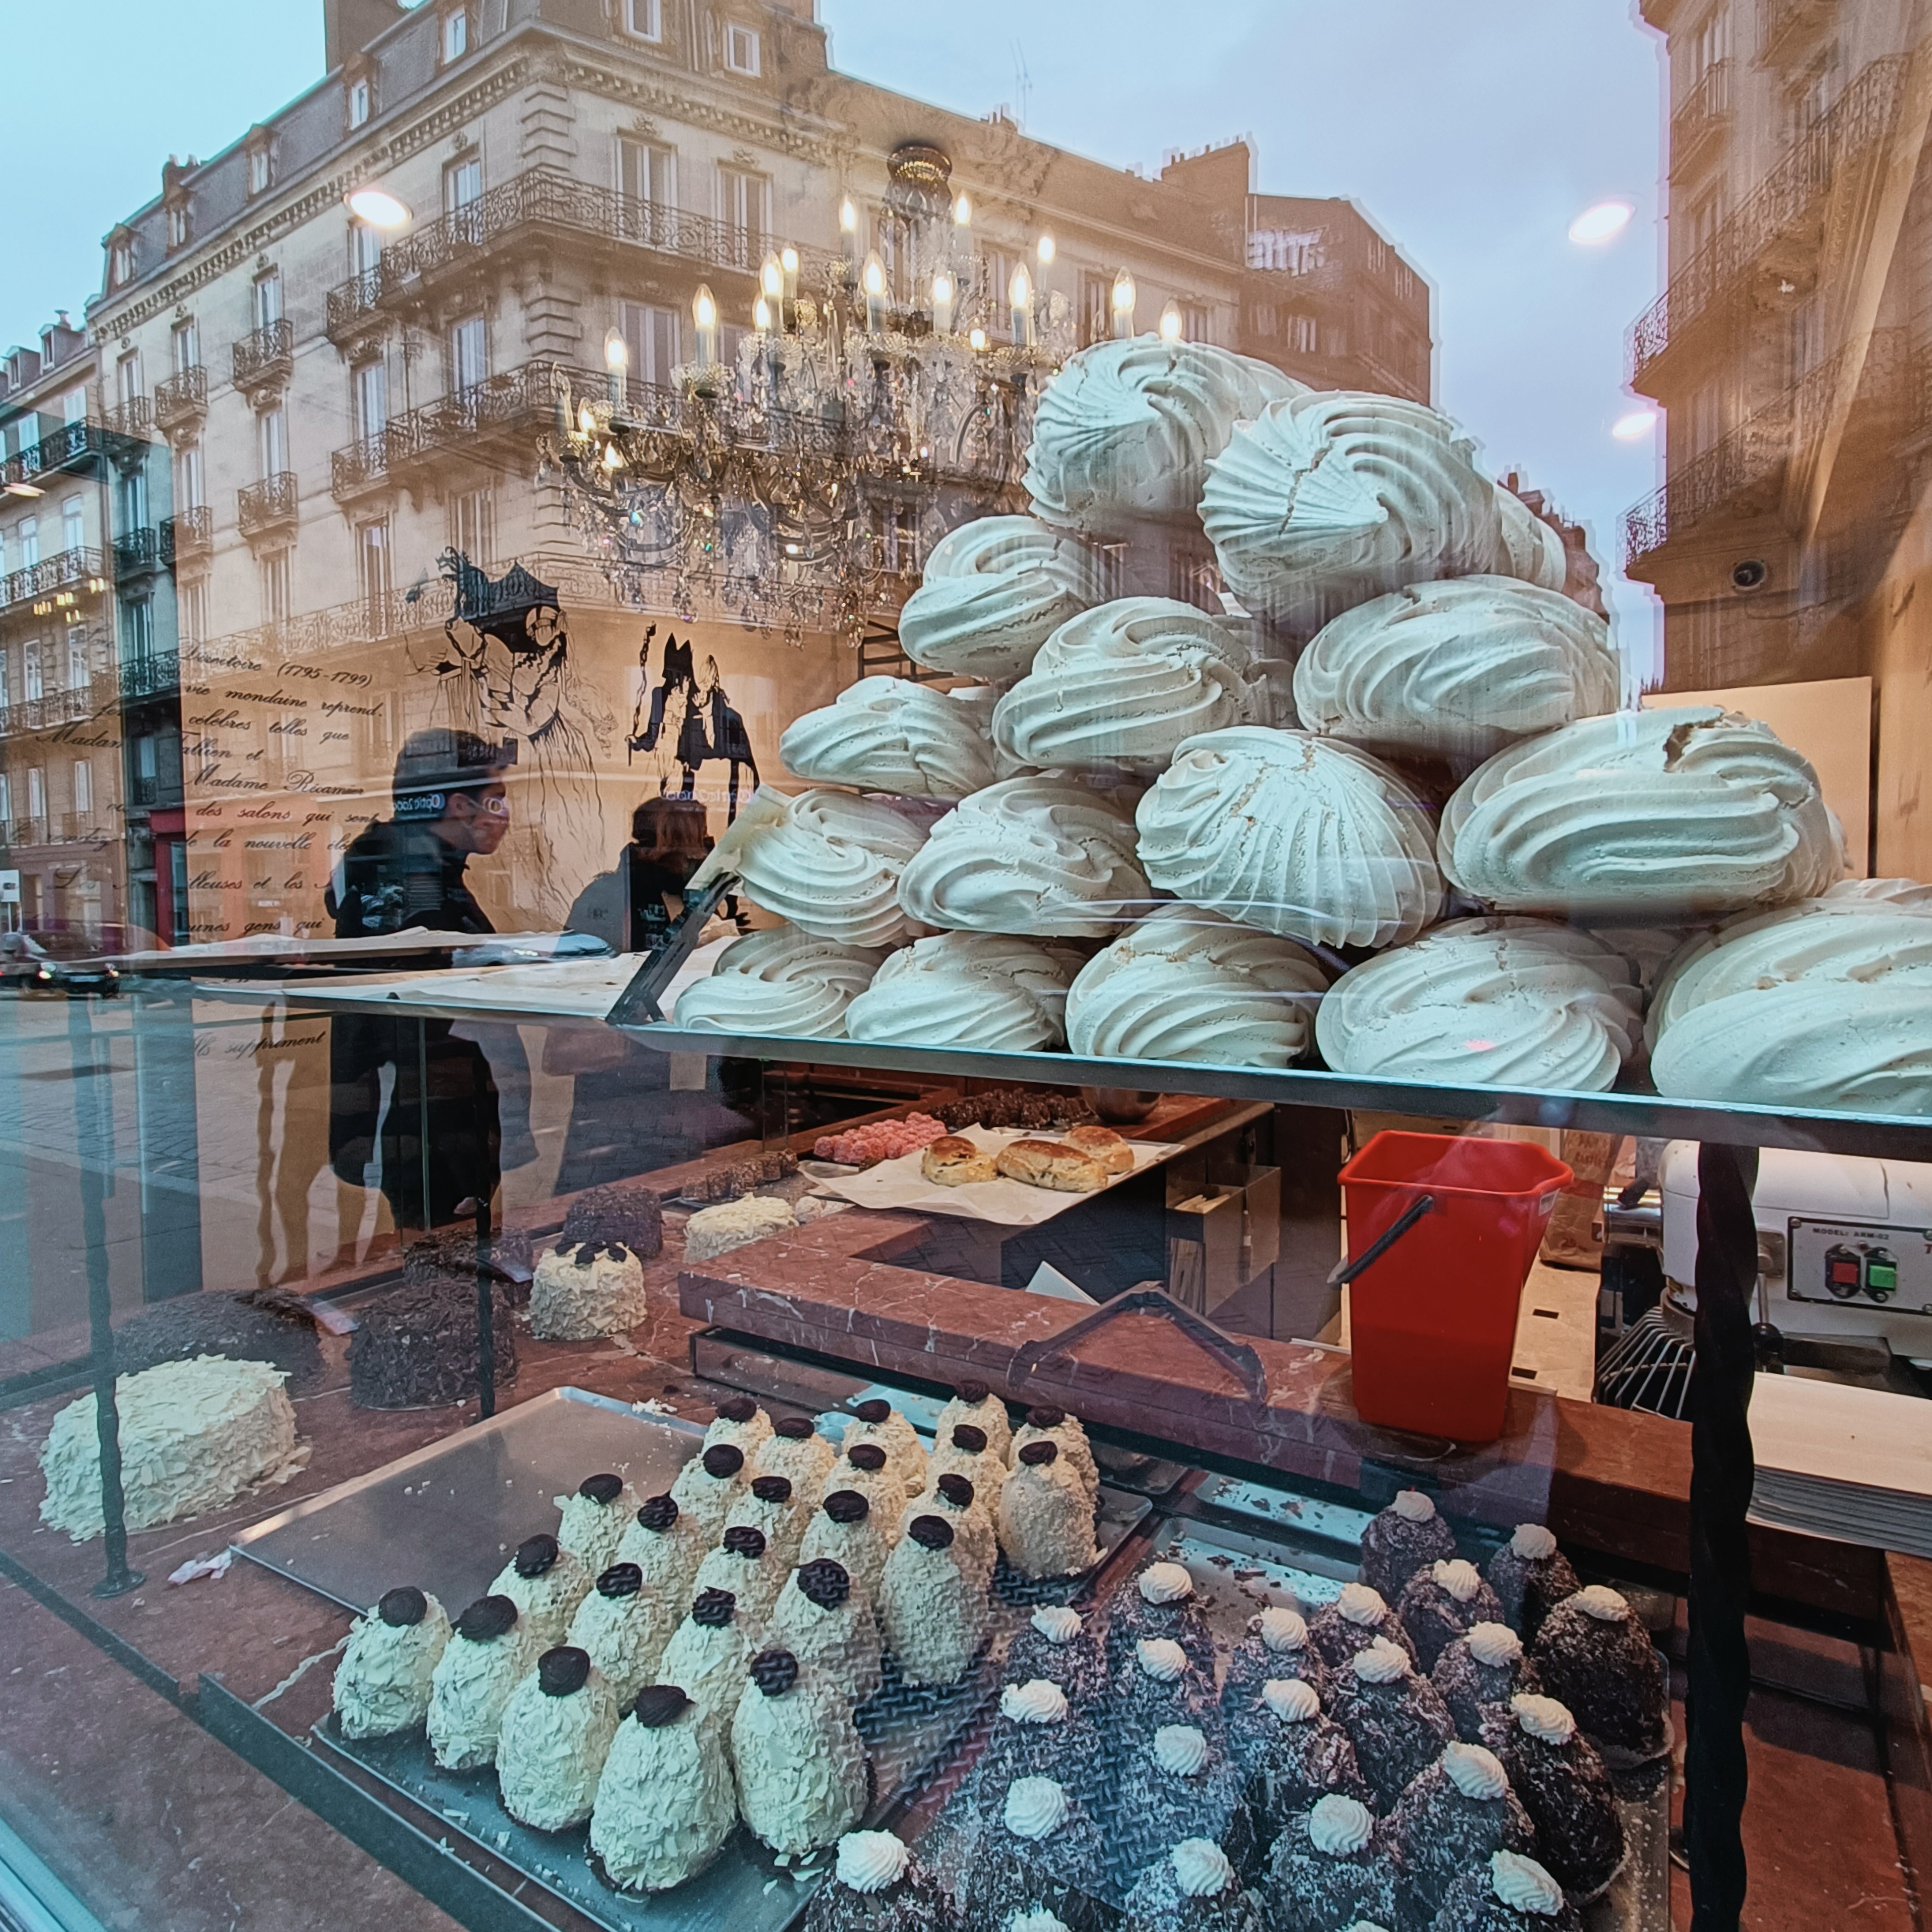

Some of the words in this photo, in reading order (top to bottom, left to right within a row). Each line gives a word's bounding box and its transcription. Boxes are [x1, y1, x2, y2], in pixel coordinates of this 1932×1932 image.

[185, 683, 210, 695] vie
[225, 689, 307, 708] mondaine
[268, 718, 308, 736] telles
[320, 730, 349, 744] que
[245, 749, 264, 761] et
[184, 763, 268, 790] Madame
[197, 801, 222, 816] des
[238, 801, 290, 819] salons
[302, 811, 335, 826] qui
[213, 829, 234, 848] la
[244, 832, 316, 850] nouvelle
[253, 876, 273, 889] et
[284, 871, 303, 889] les
[237, 921, 281, 938] gens
[294, 918, 325, 936] qui
